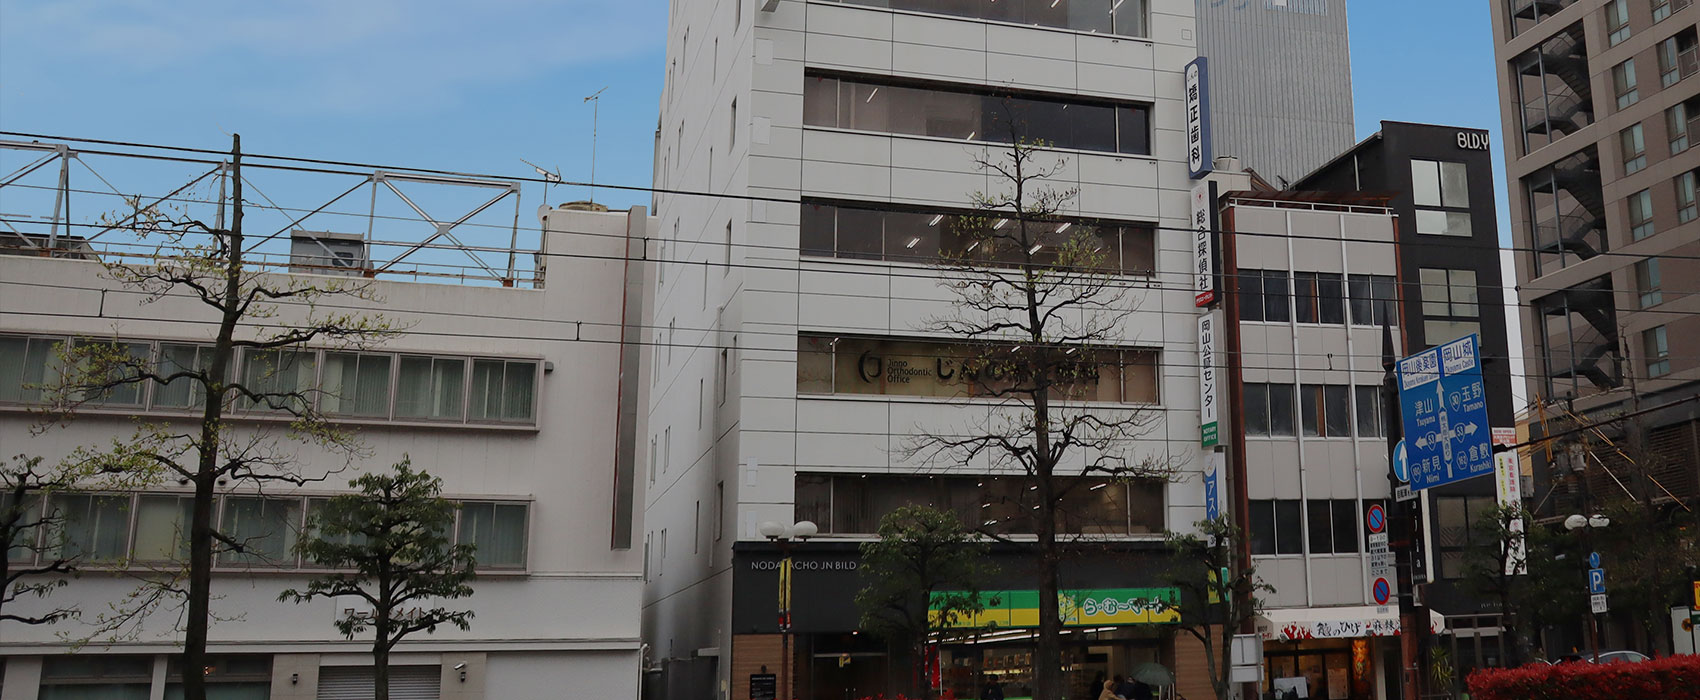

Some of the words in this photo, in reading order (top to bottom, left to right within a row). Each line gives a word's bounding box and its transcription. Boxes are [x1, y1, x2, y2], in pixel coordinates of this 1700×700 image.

[1189, 83, 1200, 164] 矯正歯科
[1196, 208, 1208, 291] 総合探偵社
[1443, 341, 1473, 363] 岡山城
[887, 359, 908, 367] Jinno
[887, 367, 932, 376] Orthodontic
[1201, 319, 1213, 419] 岡山公証センター
[887, 375, 910, 384] Office
[1461, 381, 1482, 402] 玉野
[1415, 397, 1433, 416] 津山
[1463, 401, 1484, 413] Tamano
[1416, 415, 1436, 427] Tsuyama
[1203, 433, 1217, 442] OFFICE
[1469, 443, 1490, 462] 倉敷
[1422, 455, 1441, 475] 新見
[751, 561, 819, 570] NODAACHO
[820, 561, 833, 570] JN
[835, 561, 857, 570] BILD
[1592, 571, 1601, 591] P
